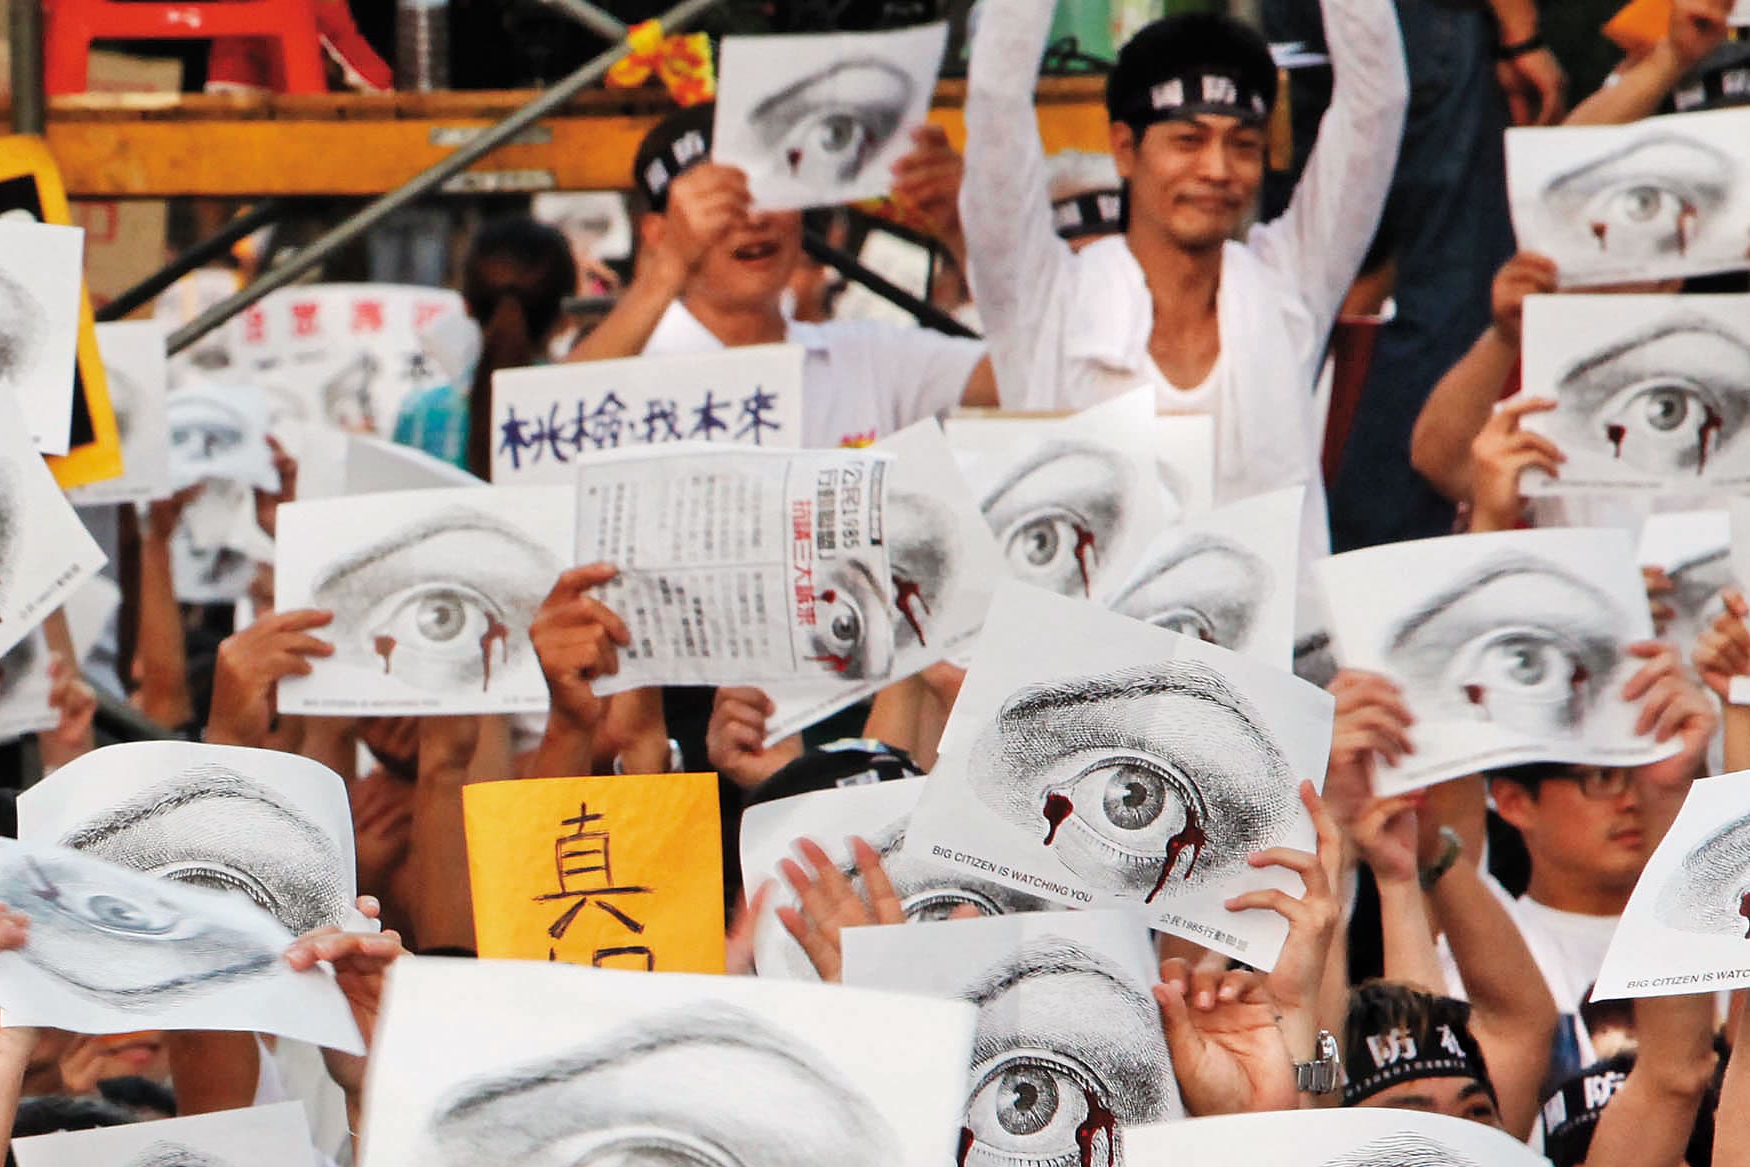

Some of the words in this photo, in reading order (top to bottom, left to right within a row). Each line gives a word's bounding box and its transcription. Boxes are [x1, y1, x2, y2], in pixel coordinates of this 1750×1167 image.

[533, 802, 656, 971] 真
[932, 845, 952, 859] BIG
[954, 852, 997, 873] CITIZEN
[998, 865, 1010, 877] IS
[1011, 870, 1069, 896] WATCHING
[1070, 889, 1093, 903] YOU
[1626, 979, 1649, 989] BIG
[1652, 974, 1700, 988] CITIZEN
[1702, 972, 1714, 982] IS
